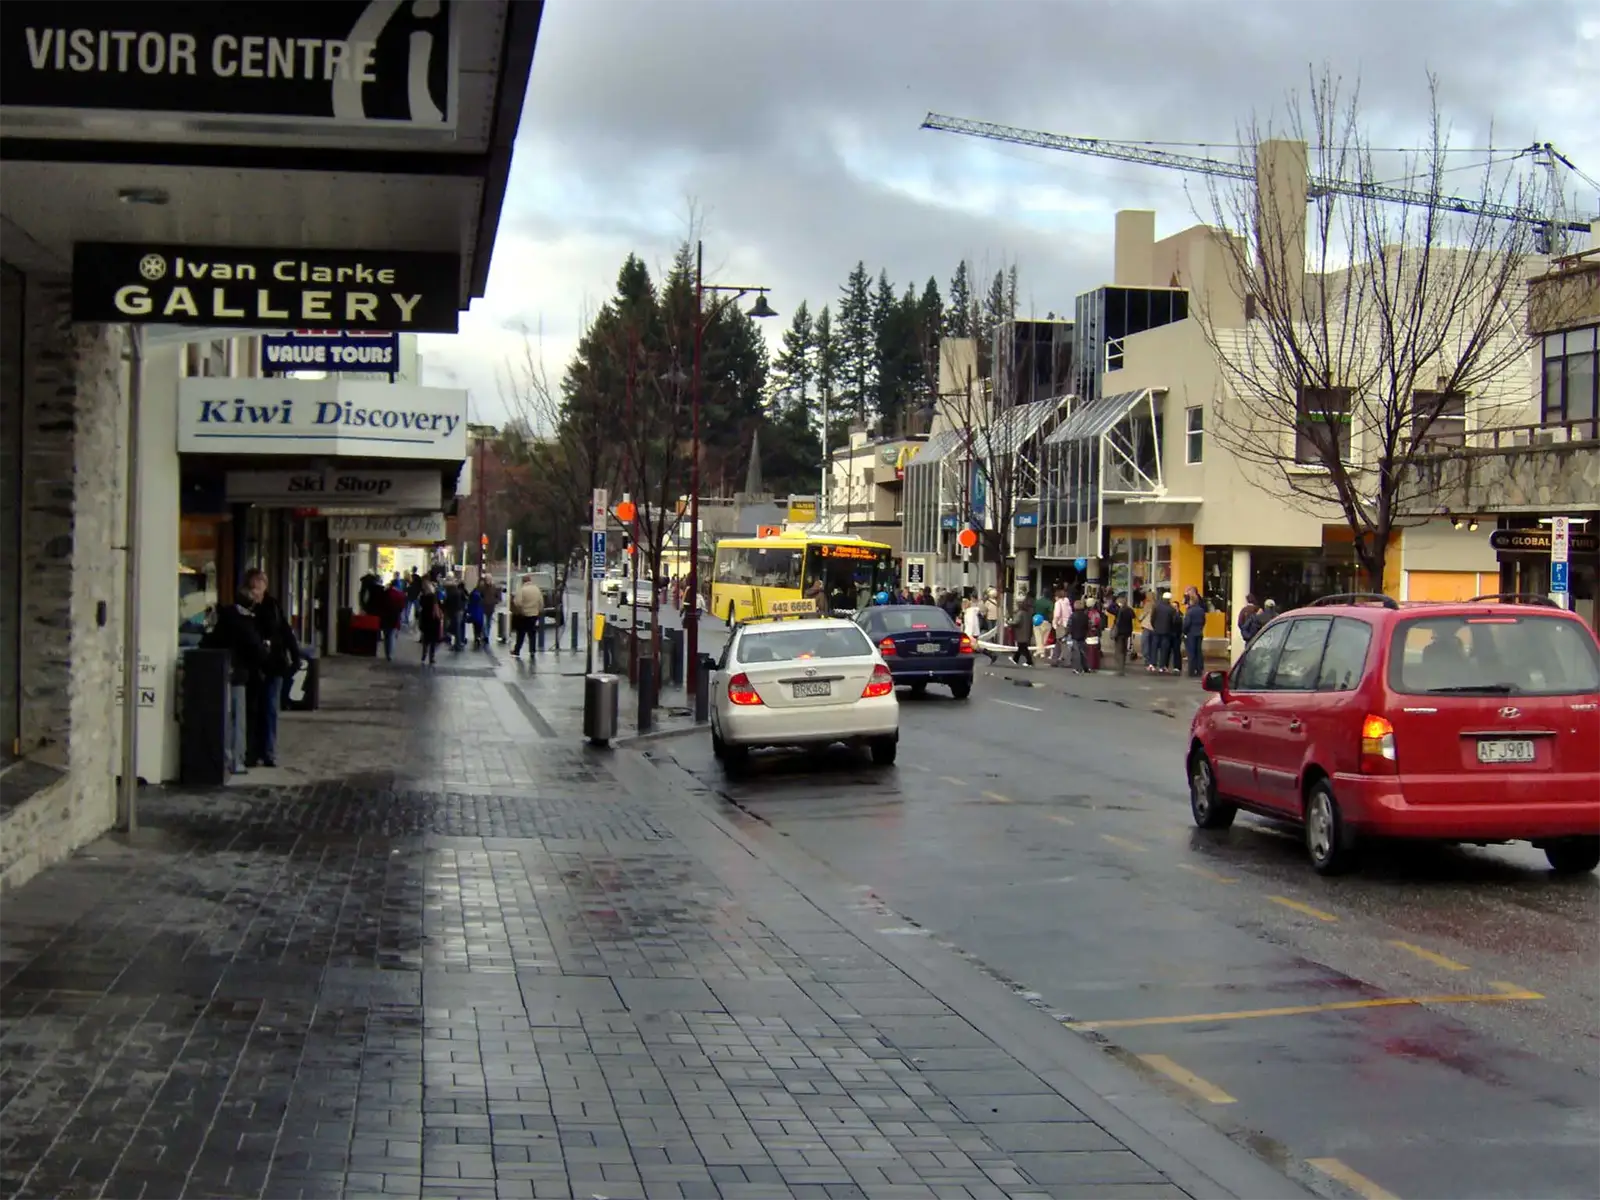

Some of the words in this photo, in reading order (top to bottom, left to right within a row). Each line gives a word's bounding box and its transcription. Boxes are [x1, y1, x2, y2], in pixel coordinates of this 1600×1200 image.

[25, 27, 196, 75] VISITOR
[211, 34, 377, 82] CENTRE
[174, 257, 256, 280] Ivan
[272, 260, 396, 284] Clarke
[113, 284, 423, 322] GALLERY
[267, 345, 326, 363] VALUE
[330, 346, 393, 363] TOURS
[197, 398, 293, 425] Kiwi
[311, 401, 460, 437] Discovery
[287, 475, 325, 492] Ski
[334, 476, 393, 495] Shop
[1511, 536, 1552, 547] GLOBAL
